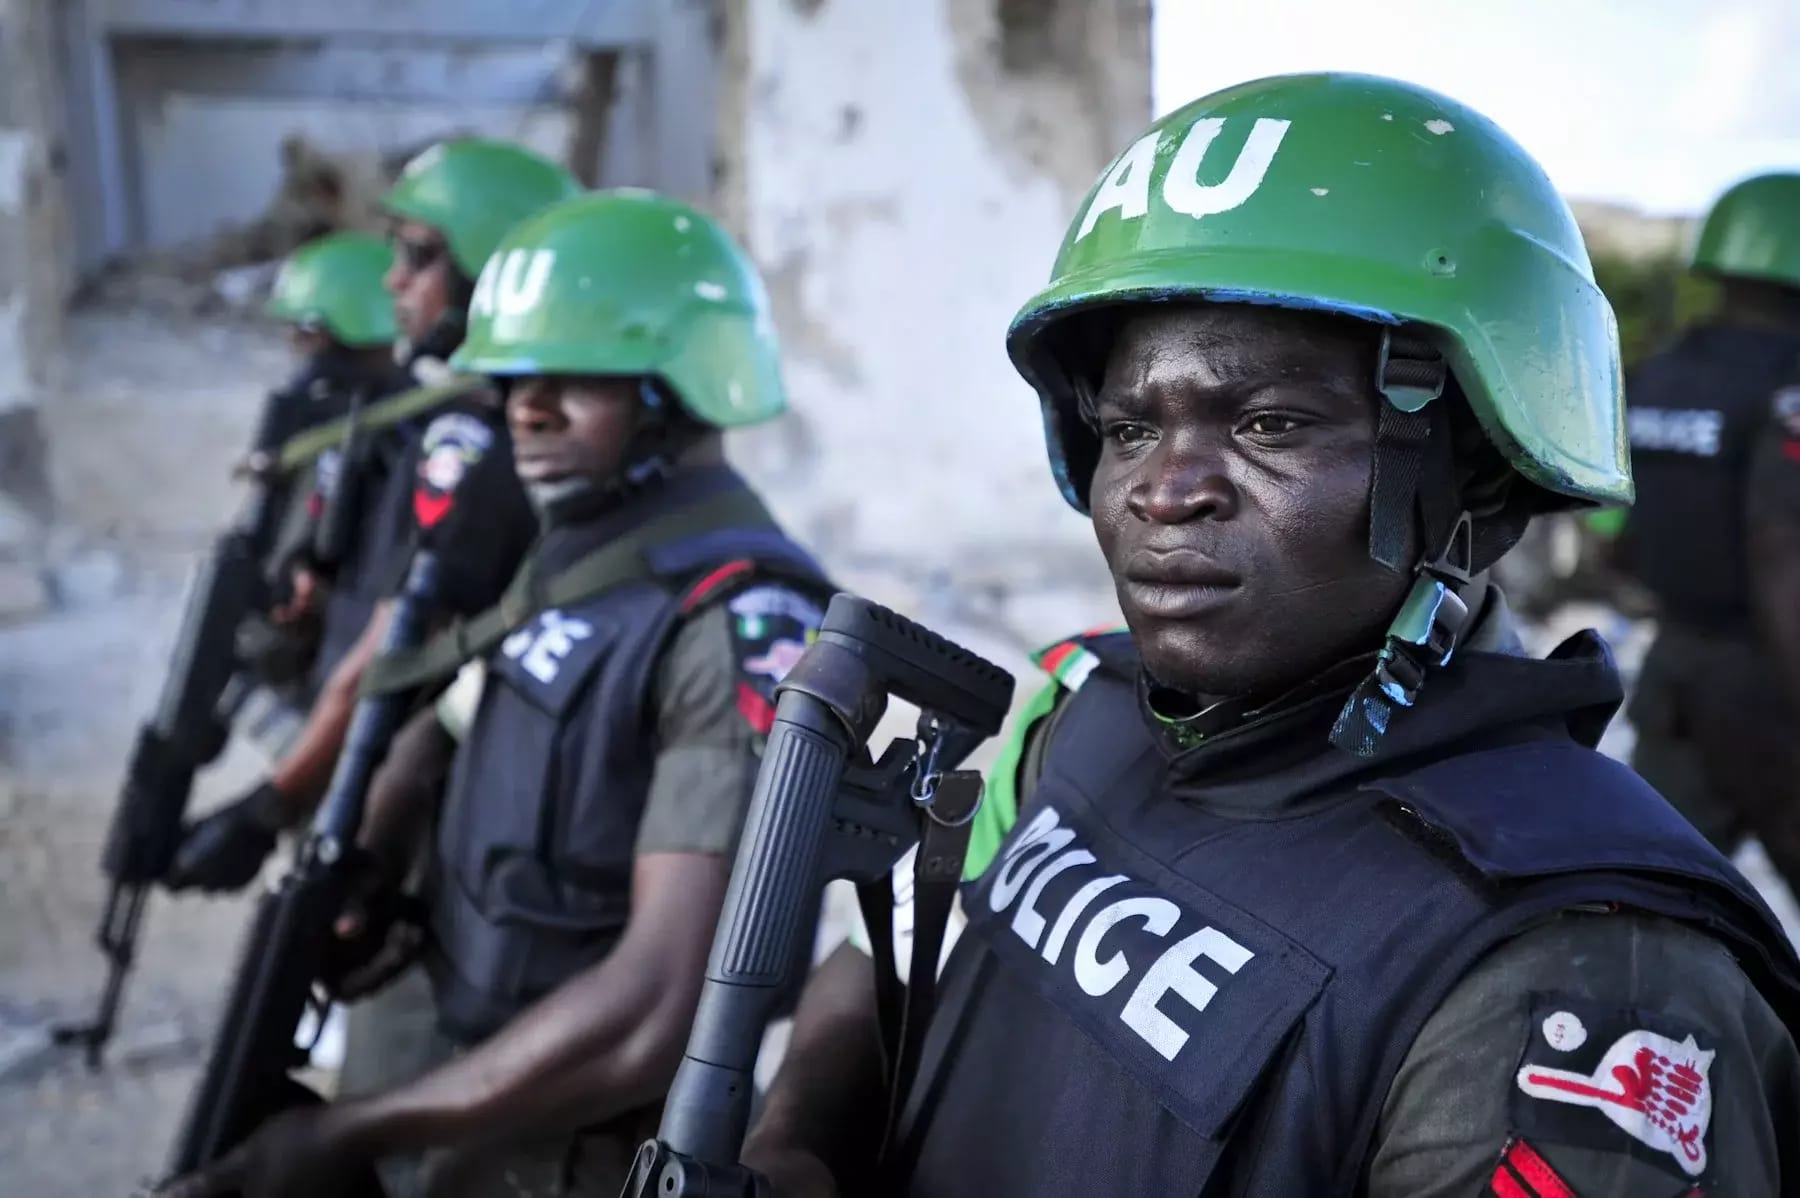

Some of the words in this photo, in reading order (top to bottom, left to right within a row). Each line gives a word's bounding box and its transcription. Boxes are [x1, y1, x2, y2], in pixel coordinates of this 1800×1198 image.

[1074, 116, 1292, 244] AU
[467, 248, 556, 319] AU
[989, 805, 1255, 1062] POLICE
